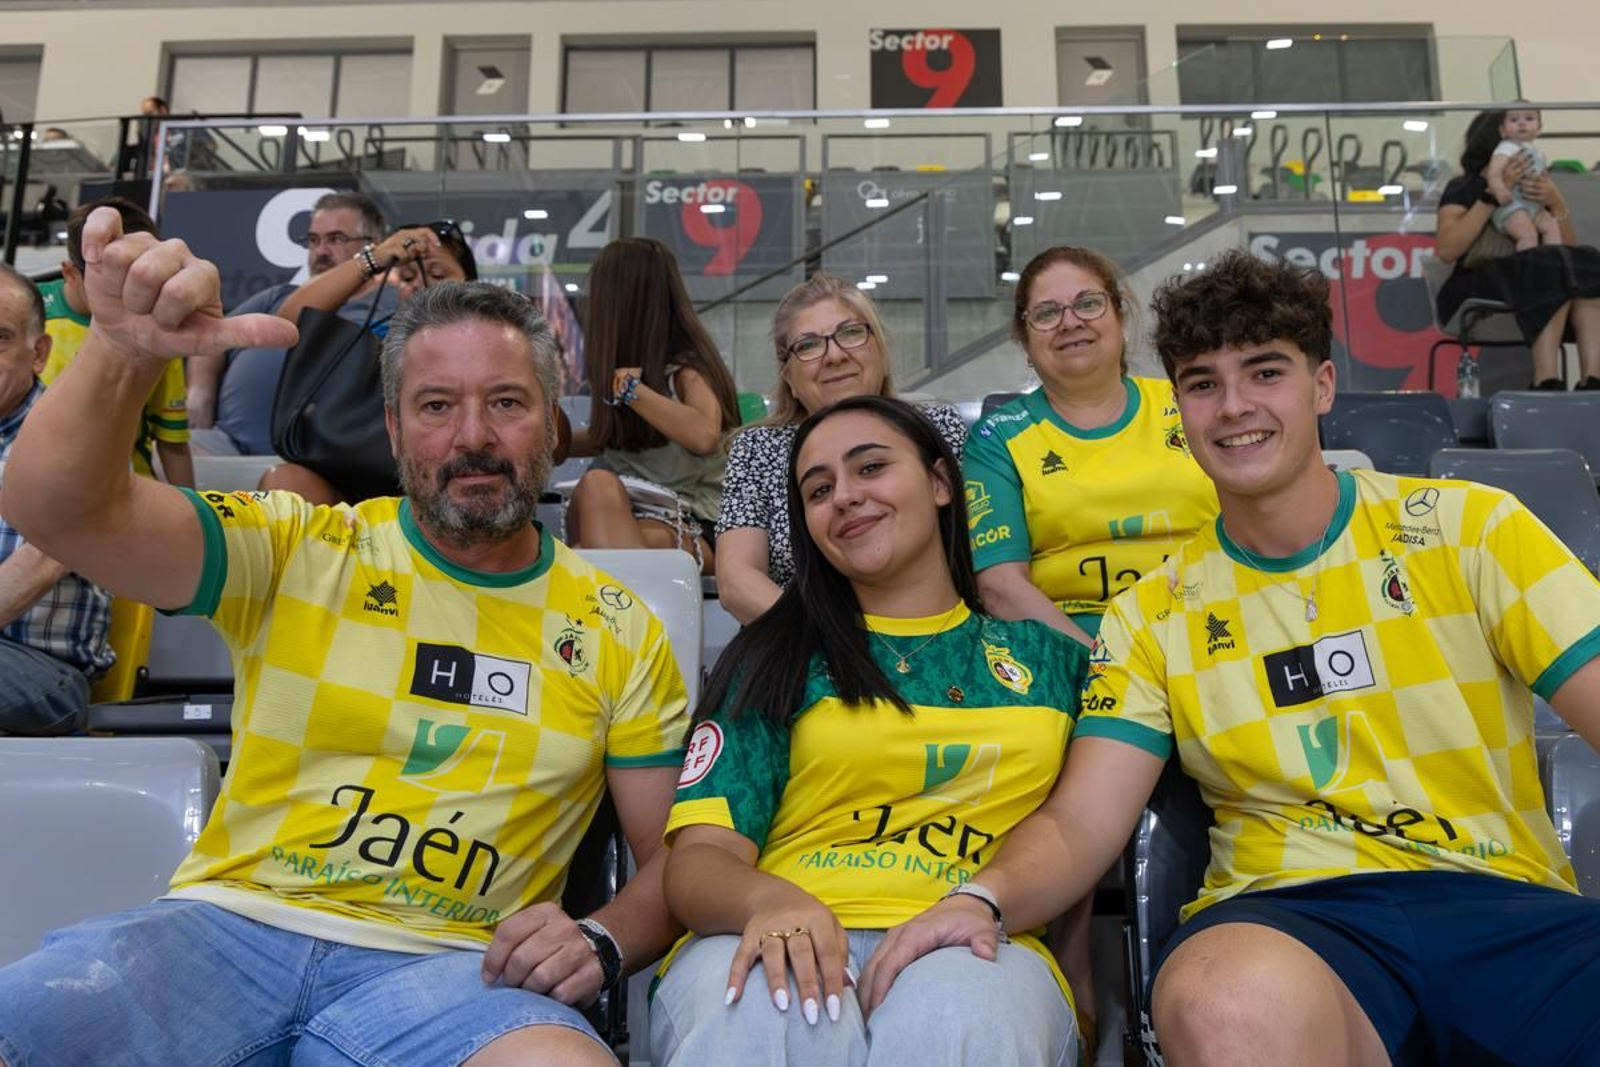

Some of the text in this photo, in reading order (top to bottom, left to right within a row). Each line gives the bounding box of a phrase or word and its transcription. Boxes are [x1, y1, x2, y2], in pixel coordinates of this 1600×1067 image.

[869, 29, 954, 51] Sector
[903, 28, 976, 109] 9
[645, 180, 737, 204] Sector
[681, 178, 763, 277] 9
[1251, 235, 1435, 280] Sector
[309, 784, 500, 896] Jaén
[903, 854, 971, 885] INTER
